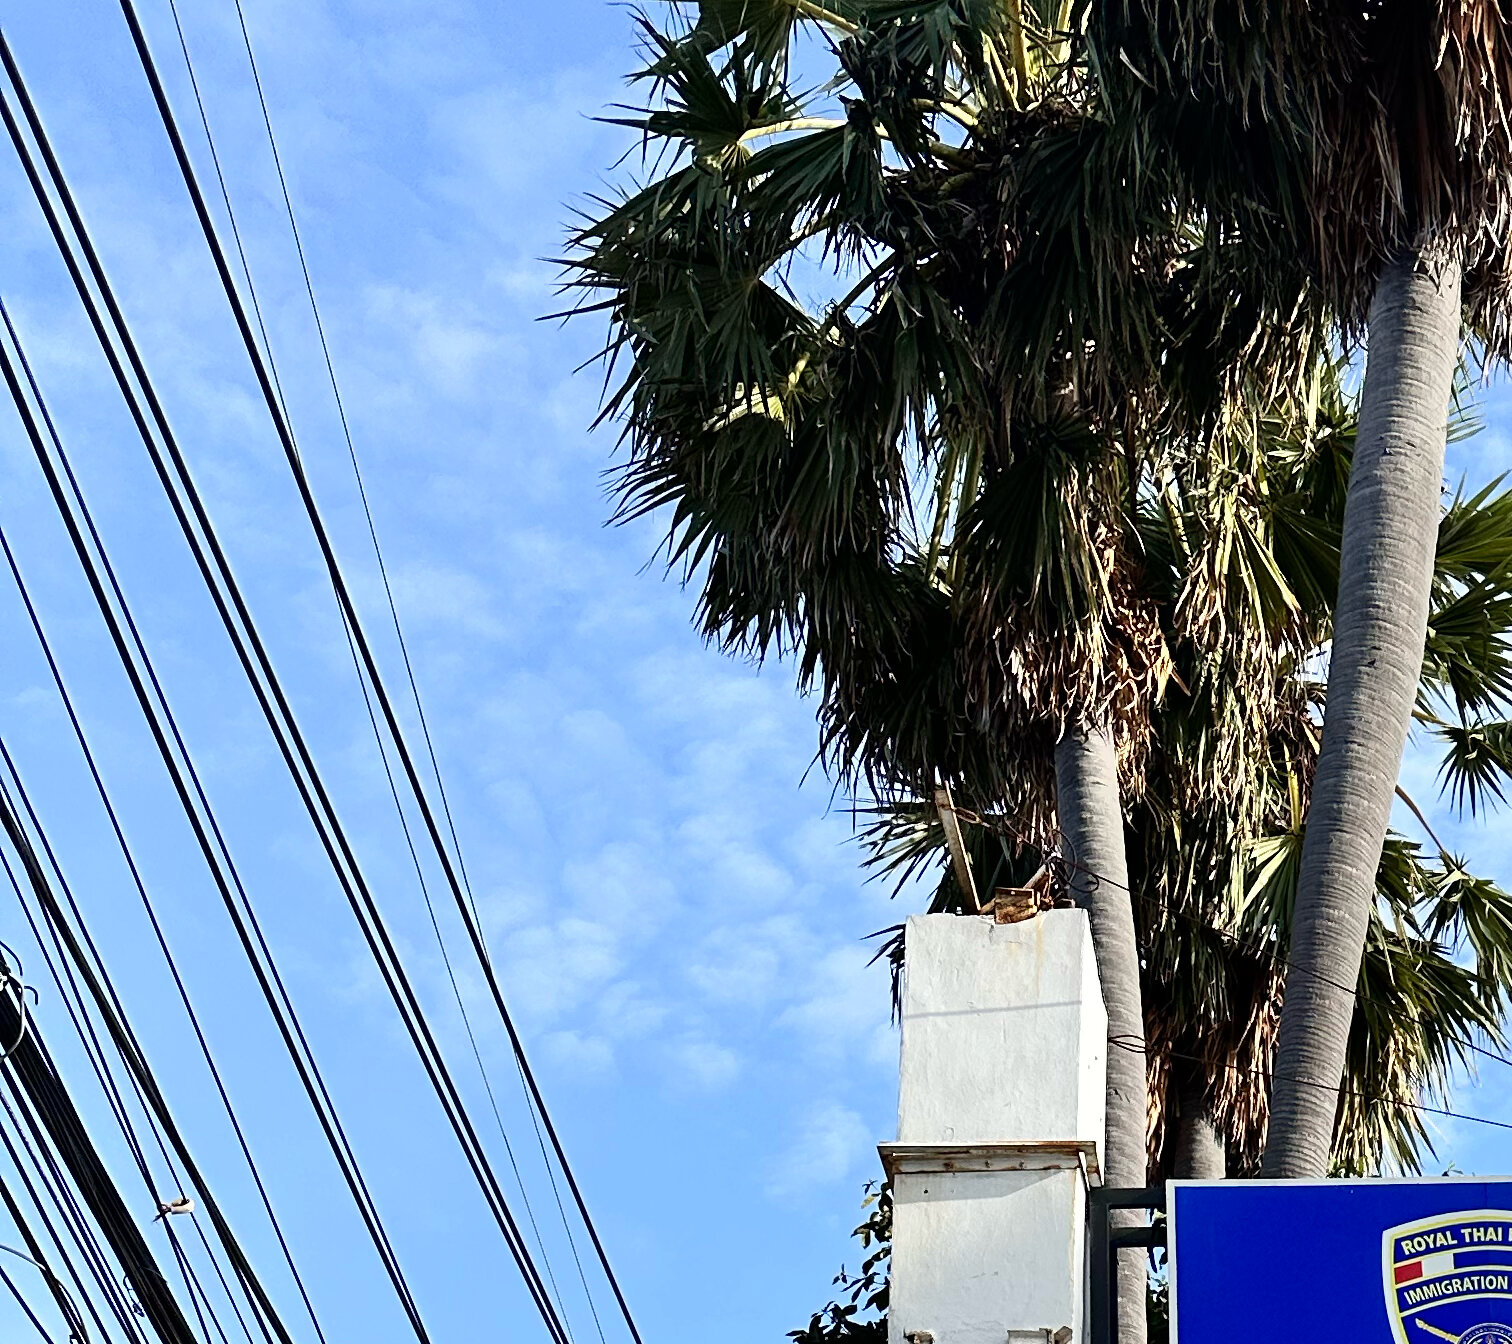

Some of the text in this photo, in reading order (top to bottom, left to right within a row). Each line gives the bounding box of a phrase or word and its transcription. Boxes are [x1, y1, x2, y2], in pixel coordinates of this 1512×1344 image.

[1401, 1231, 1458, 1255] ROYAL
[1461, 1227, 1503, 1243] THAI
[1404, 1275, 1509, 1305] IMMIGRATION
